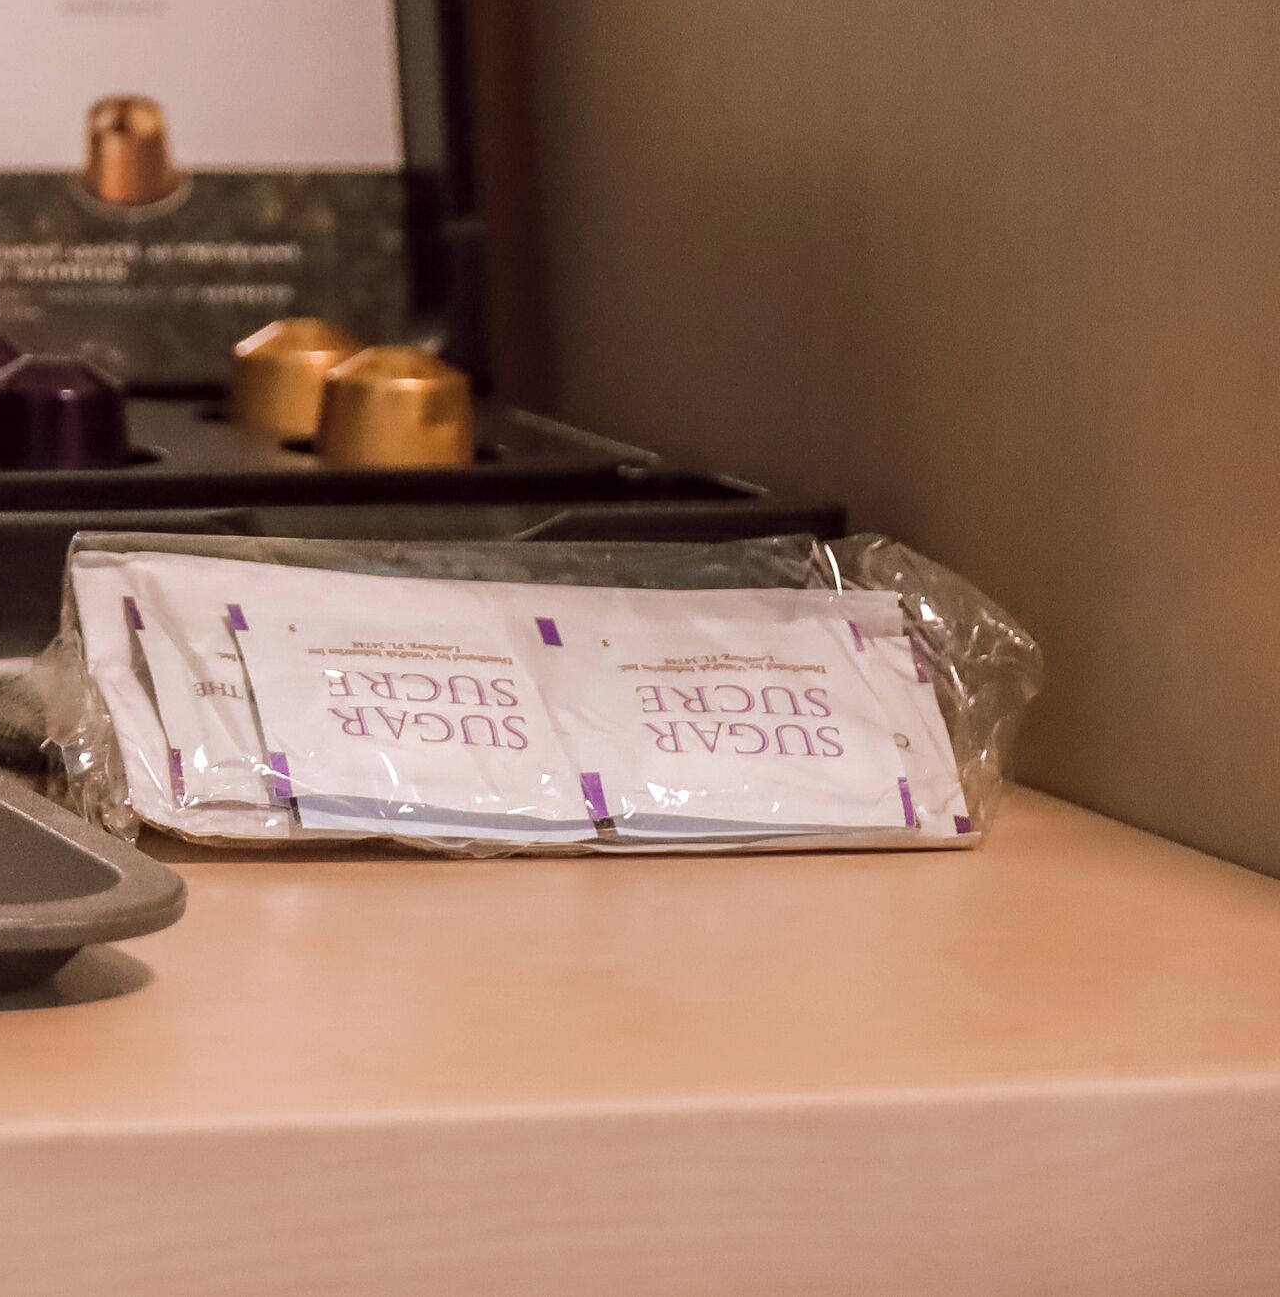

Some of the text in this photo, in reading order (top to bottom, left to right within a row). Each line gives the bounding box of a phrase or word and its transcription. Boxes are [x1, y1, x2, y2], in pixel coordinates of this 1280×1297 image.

[322, 670, 519, 708] SUCRE
[635, 684, 833, 719] SUCRE
[327, 706, 529, 752] SUGAR
[640, 720, 845, 759] SUGAR
